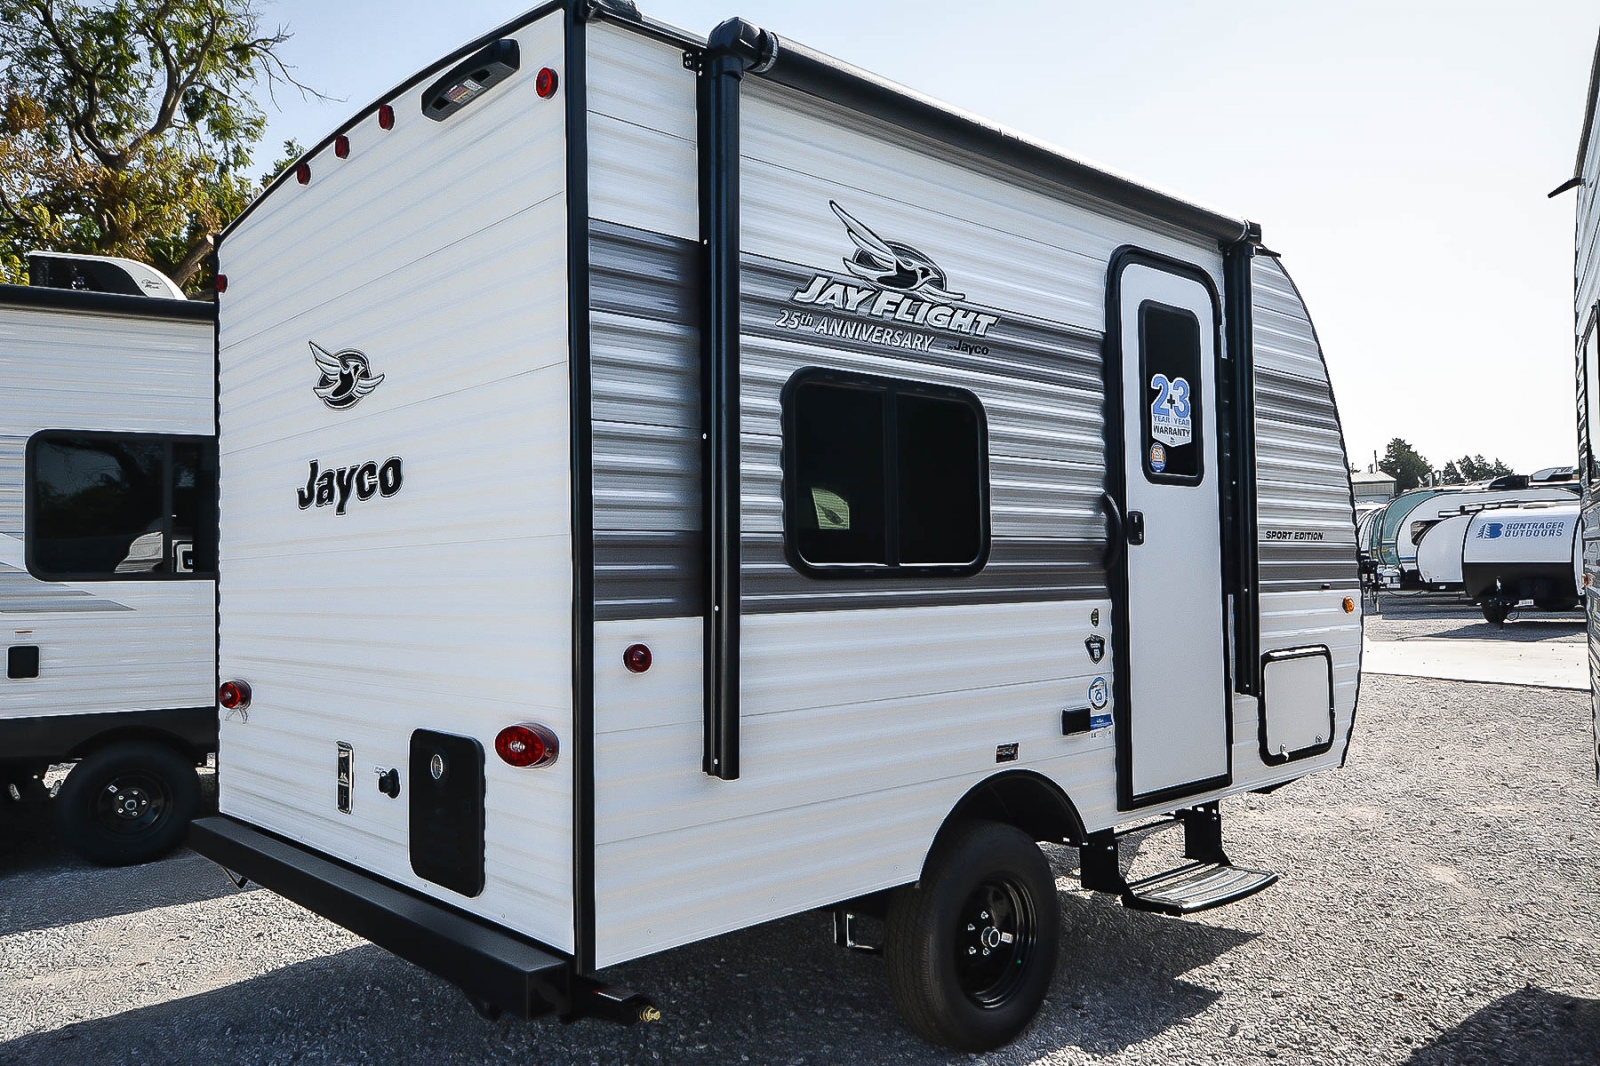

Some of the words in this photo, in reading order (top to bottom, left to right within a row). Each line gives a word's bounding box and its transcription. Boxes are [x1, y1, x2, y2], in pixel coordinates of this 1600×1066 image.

[791, 275, 875, 313] JAY
[870, 290, 999, 337] FLIGHT
[775, 309, 814, 330] 25th
[815, 316, 936, 352] ANNIVERSARY
[954, 339, 989, 355] Jayco
[1153, 414, 1170, 423] YEAR
[1173, 417, 1190, 427] YEAR
[1153, 425, 1190, 437] WARRANTY
[297, 457, 403, 516] Jayco
[1506, 521, 1564, 530] BONTRAGER
[1266, 531, 1292, 539] SPORT
[1294, 532, 1324, 540] EDITION
[1504, 528, 1563, 537] OUTDOORS
